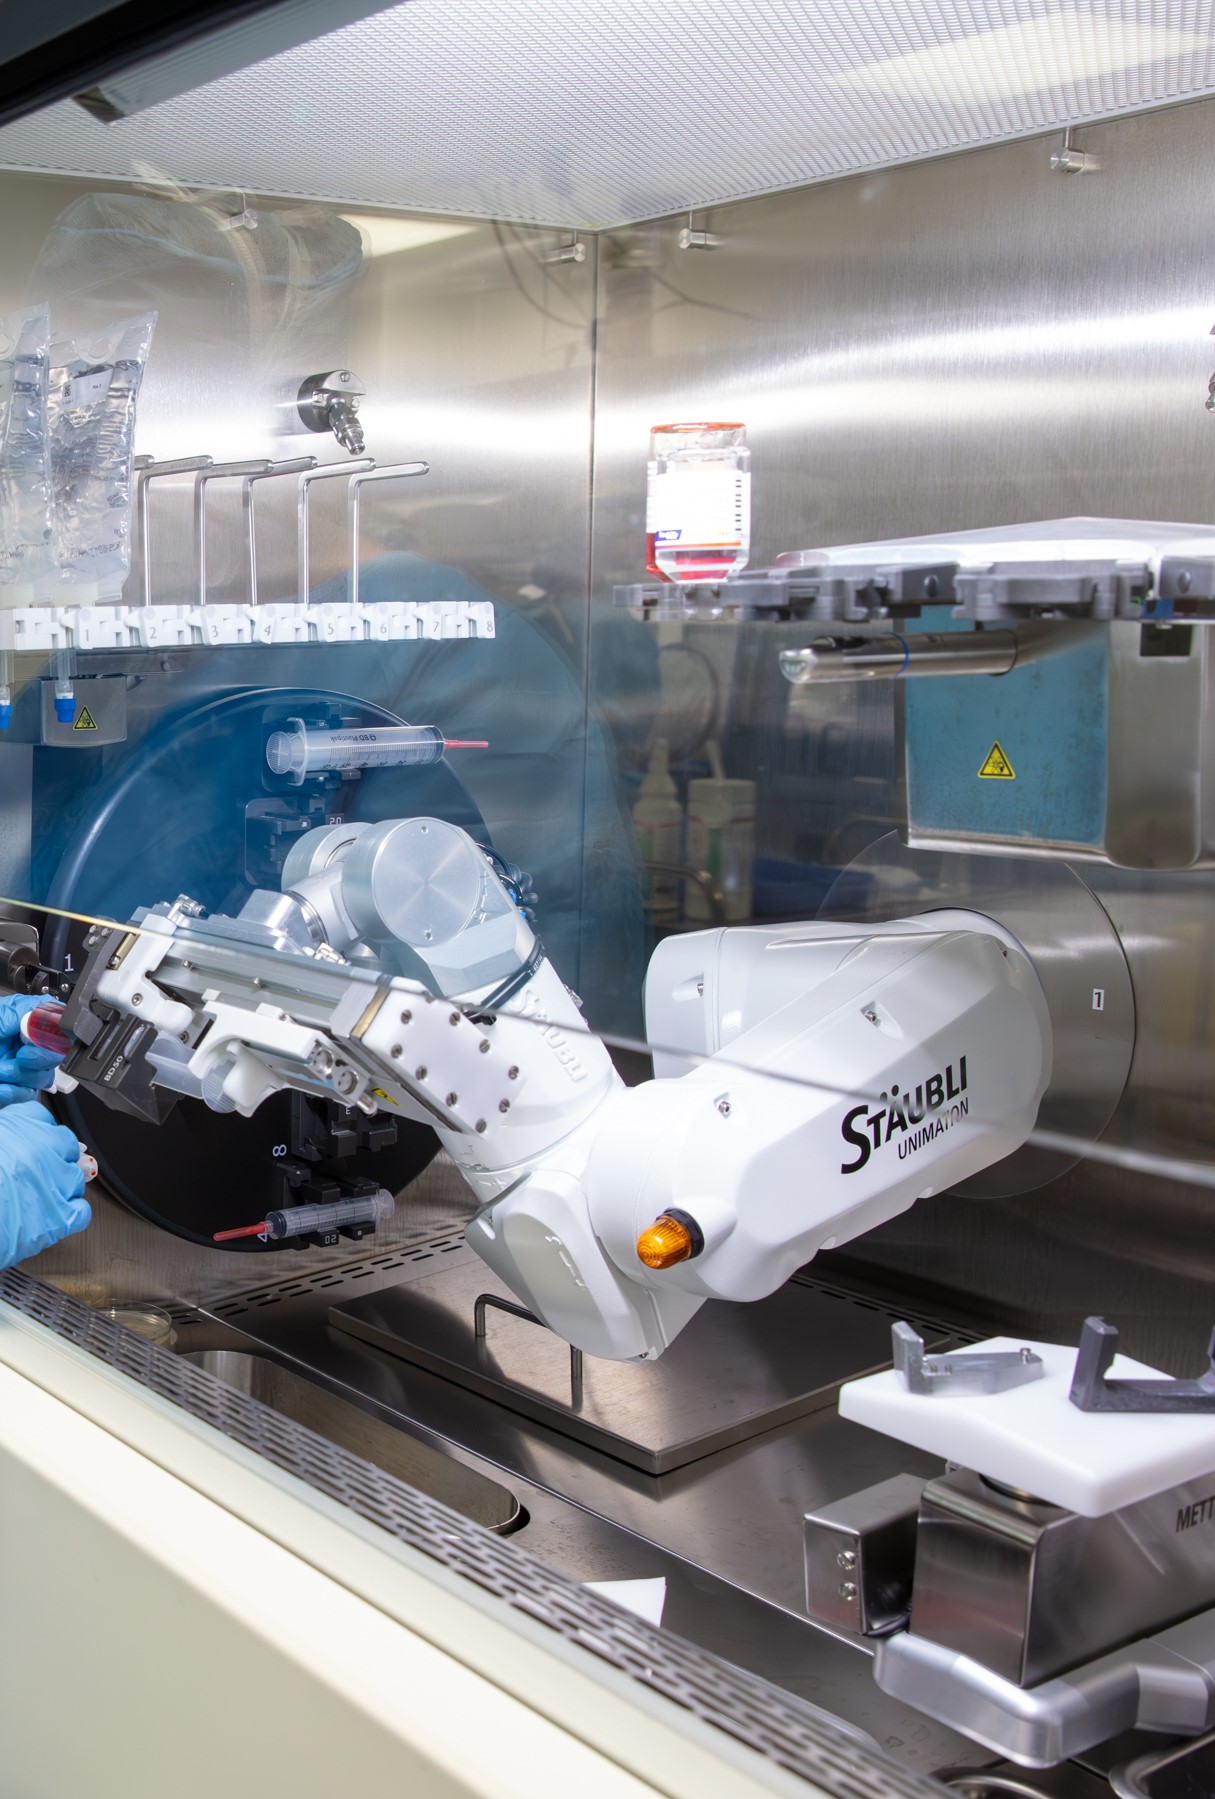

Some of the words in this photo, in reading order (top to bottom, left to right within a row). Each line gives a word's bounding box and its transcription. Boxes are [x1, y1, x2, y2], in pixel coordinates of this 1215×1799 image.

[149, 627, 158, 640] 2
[211, 625, 219, 638] 3
[263, 624, 272, 637] 4
[327, 623, 335, 635] 5
[380, 622, 388, 633] 6
[433, 621, 440, 632] 7
[486, 621, 494, 632] 8
[329, 735, 358, 743] Plastipak
[64, 953, 74, 972] 1
[1094, 991, 1102, 1008] 1
[104, 1055, 124, 1082] BD50
[841, 1055, 968, 1175] STÄUBLI
[897, 1096, 969, 1160] UNIMATION
[272, 1144, 287, 1157] 8
